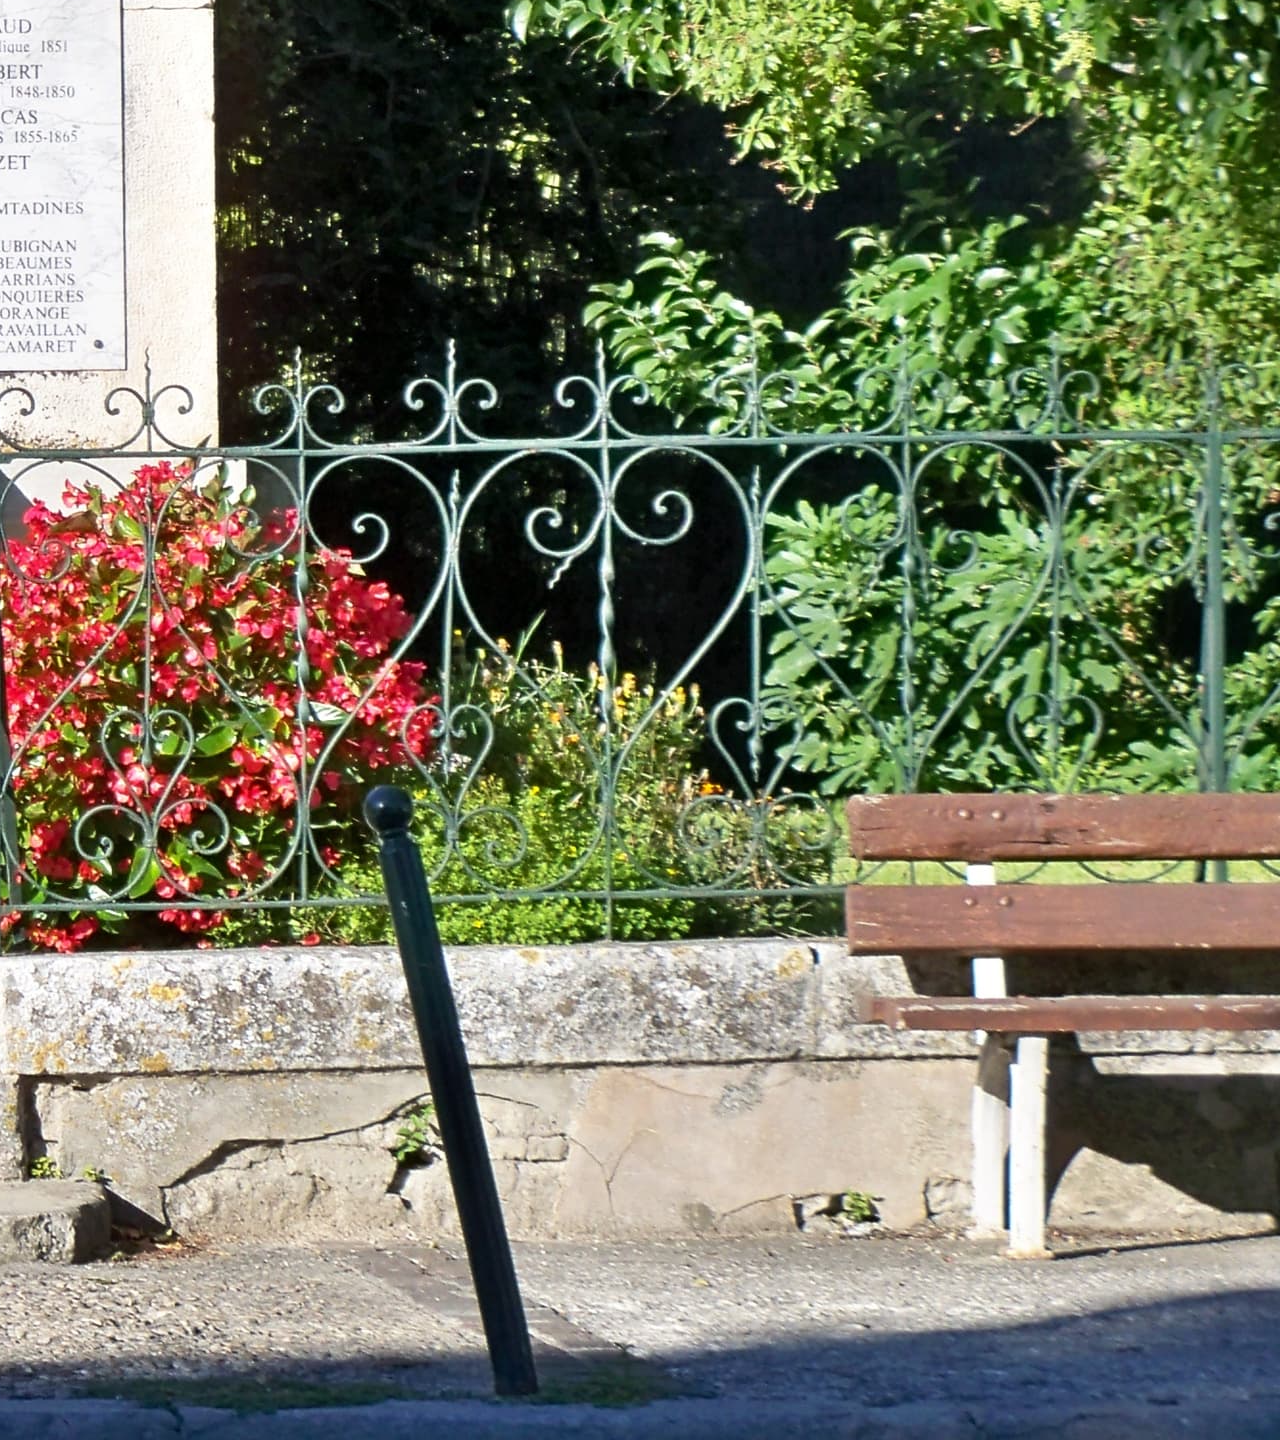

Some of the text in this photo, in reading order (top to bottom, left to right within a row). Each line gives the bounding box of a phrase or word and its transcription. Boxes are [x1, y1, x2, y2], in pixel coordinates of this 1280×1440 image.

[10, 84, 76, 99] 1848-1850
[14, 129, 79, 144] 1855-1865
[0, 307, 71, 320] ORANGE
